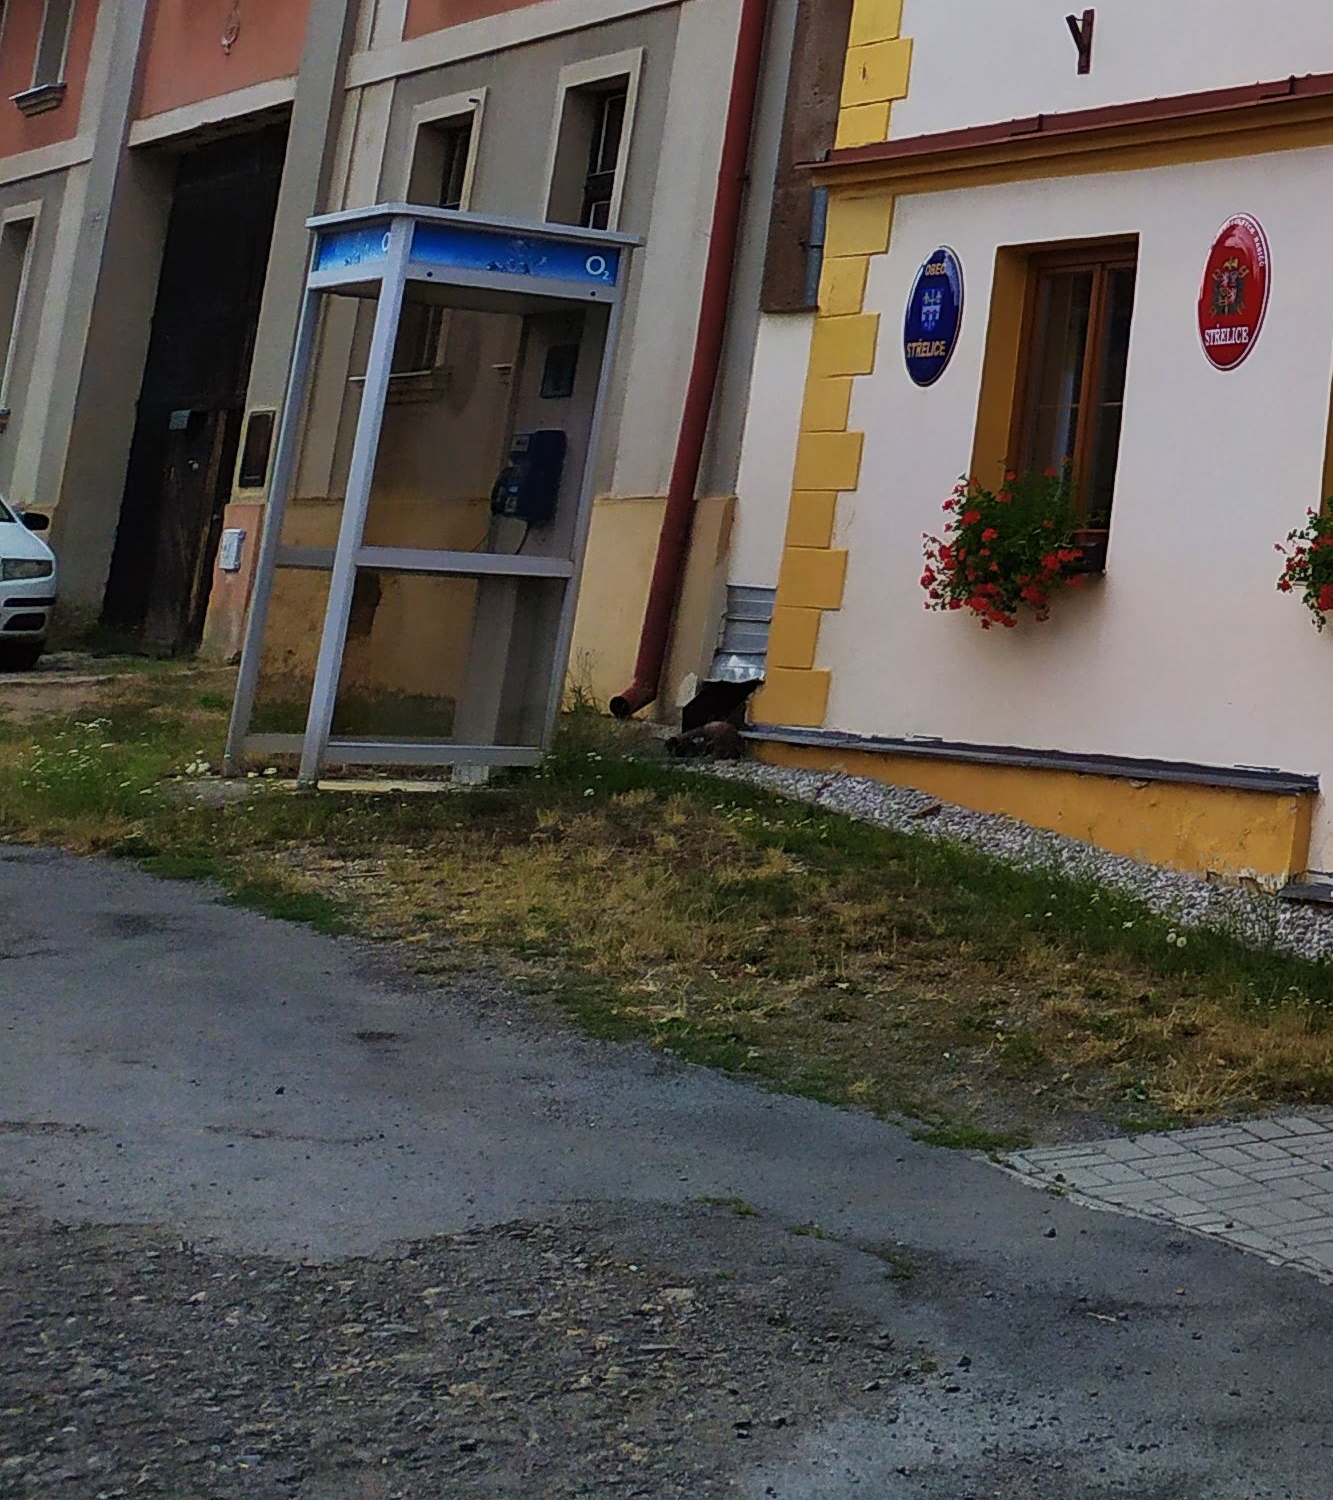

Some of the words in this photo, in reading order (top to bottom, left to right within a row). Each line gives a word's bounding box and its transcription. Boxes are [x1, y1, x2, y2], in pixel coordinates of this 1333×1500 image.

[586, 255, 609, 280] O2
[1204, 323, 1249, 347] STŘELICE
[906, 338, 947, 359] STŘELICE
